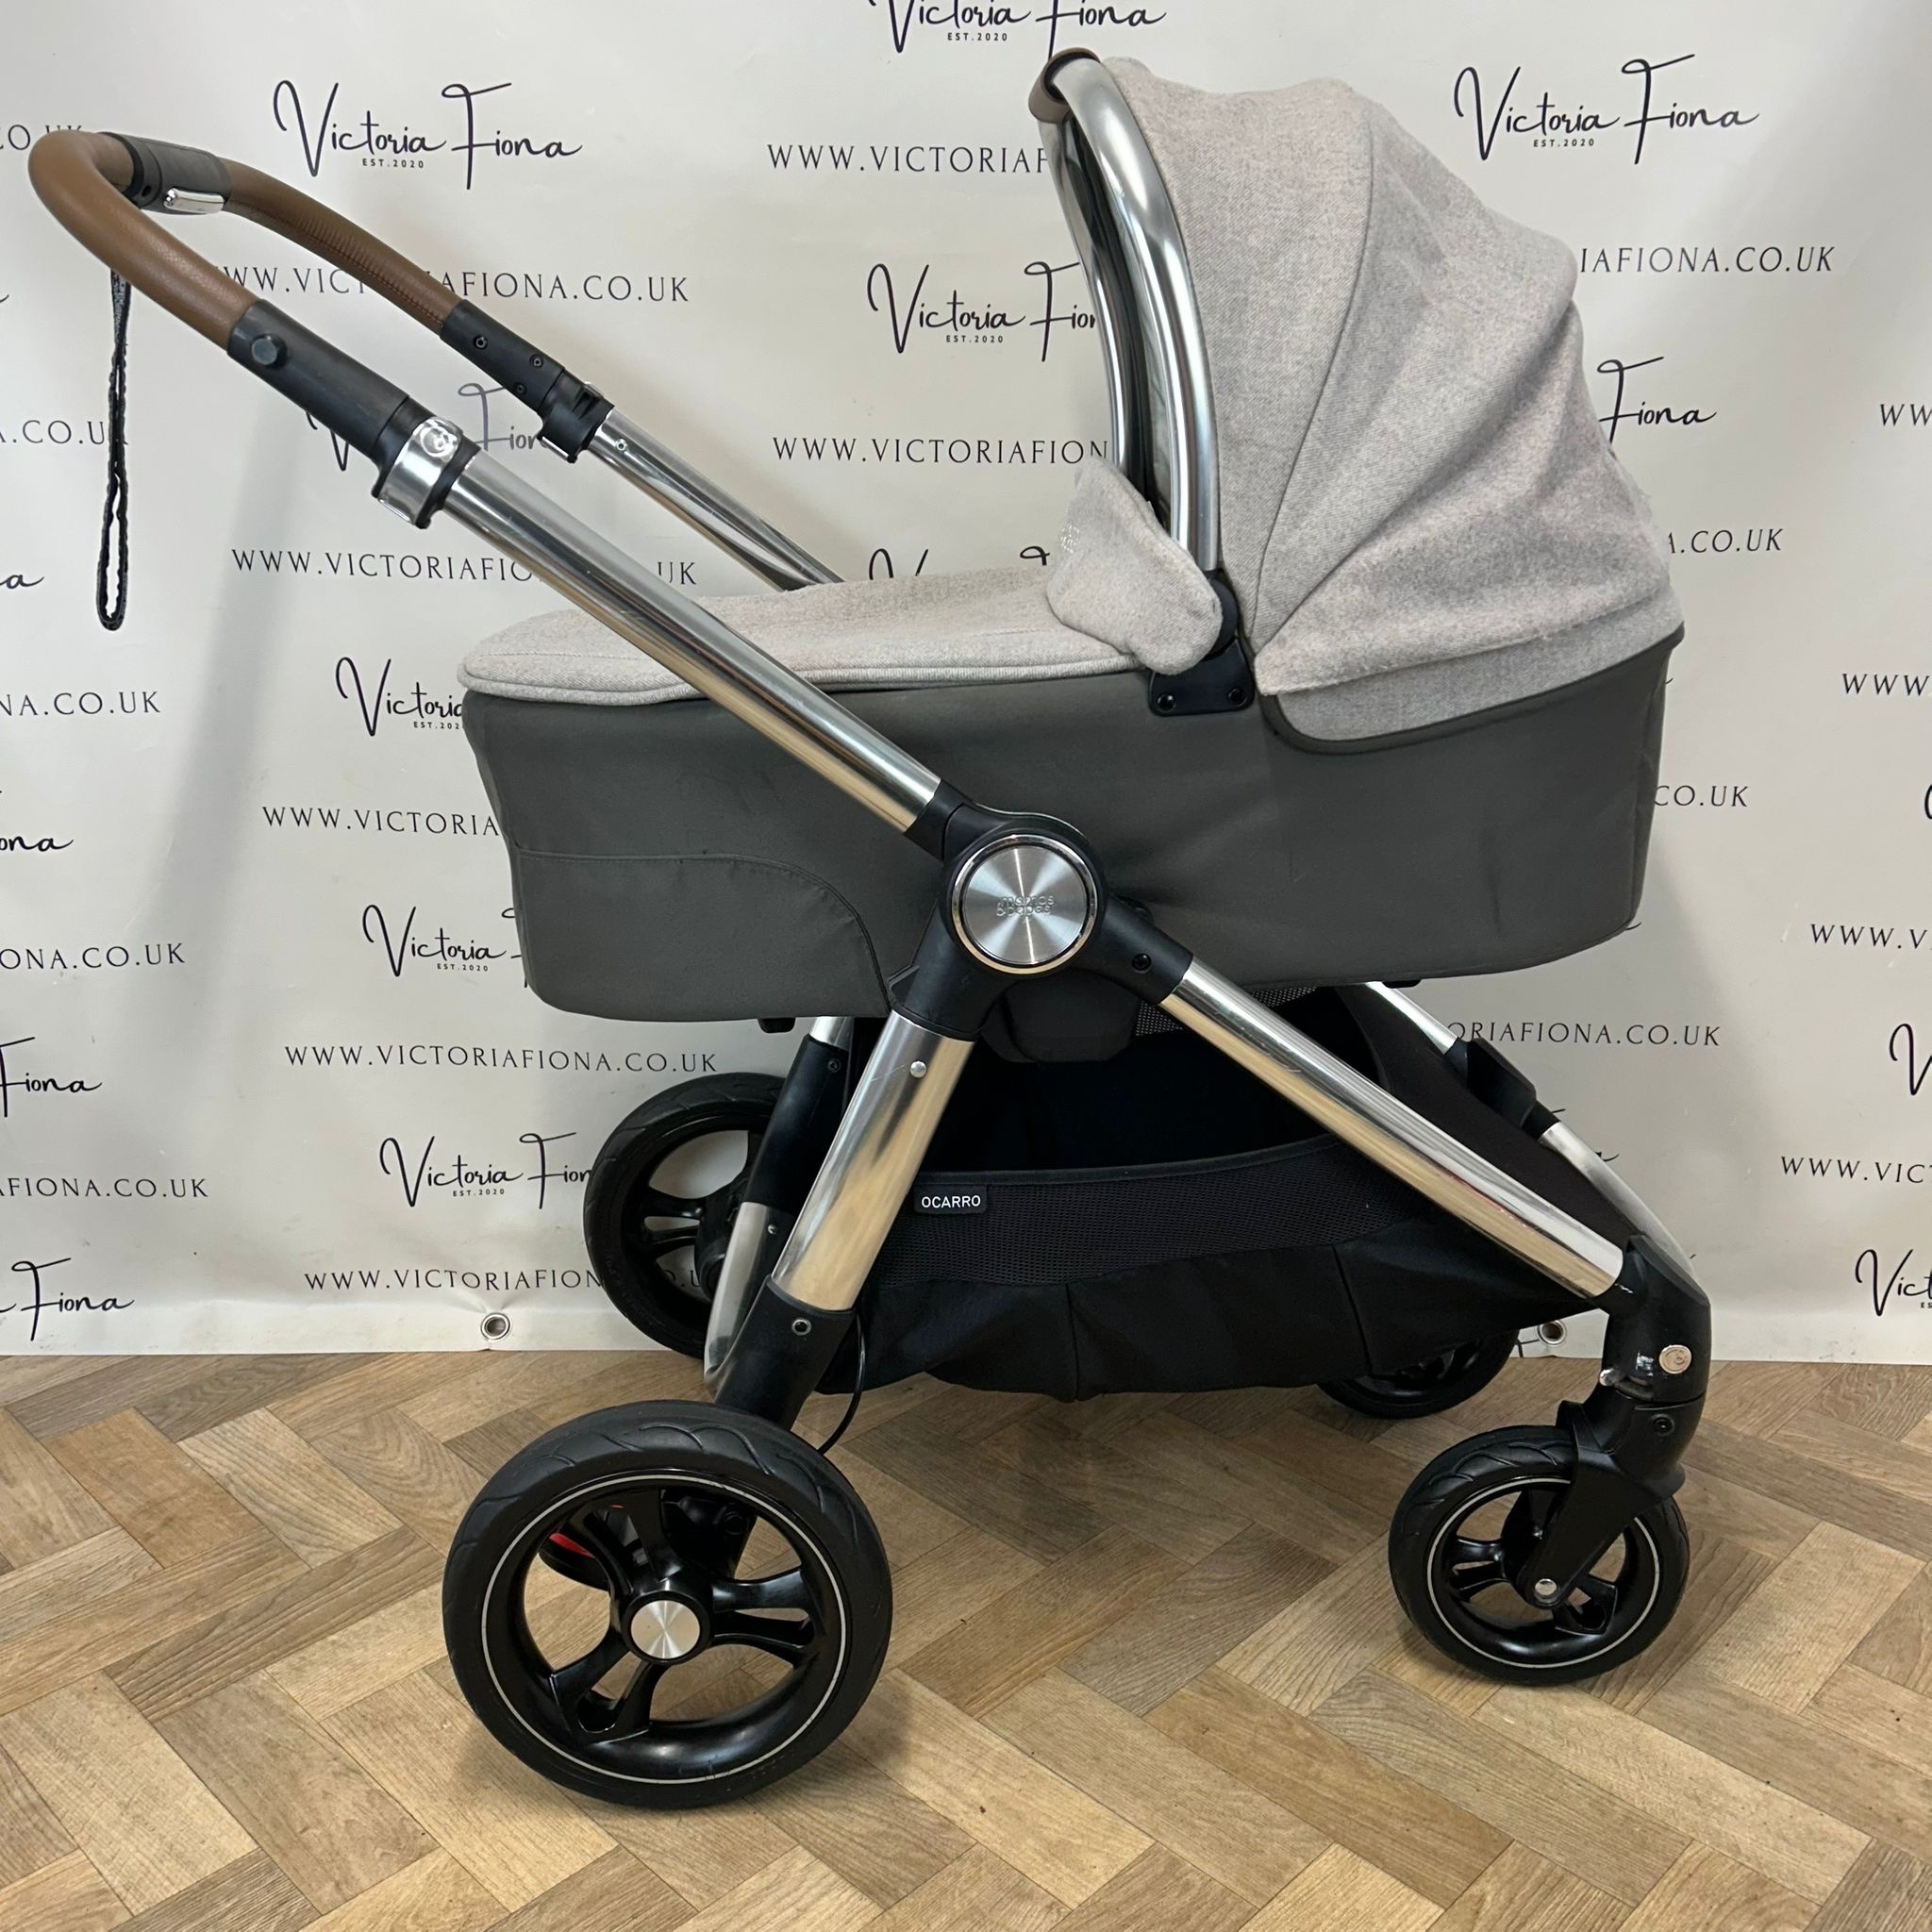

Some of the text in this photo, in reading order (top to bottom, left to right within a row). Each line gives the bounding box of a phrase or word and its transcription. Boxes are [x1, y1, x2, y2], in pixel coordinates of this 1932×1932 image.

[947, 32, 1007, 42] EST.2020
[1454, 54, 1759, 165] Victoria Fiona
[273, 80, 583, 190] Victoria Fiona
[1533, 138, 1594, 147] EST.2020
[362, 158, 425, 169] EST.2020
[867, 263, 1026, 354] Victoria
[946, 335, 1003, 343] EST.2020
[1596, 356, 1717, 444] Fiona
[362, 905, 508, 977] Victoria
[437, 963, 489, 972] EST.2020
[285, 1045, 717, 1072] WWW.VICTORIAFIONA.CO.UK
[379, 1132, 591, 1209] Victoria Fion
[1781, 1157, 1932, 1183] WWW.VIC
[453, 1188, 505, 1197] EST.2020
[921, 1195, 981, 1208] OCARRO
[11, 1257, 135, 1341] Fiona
